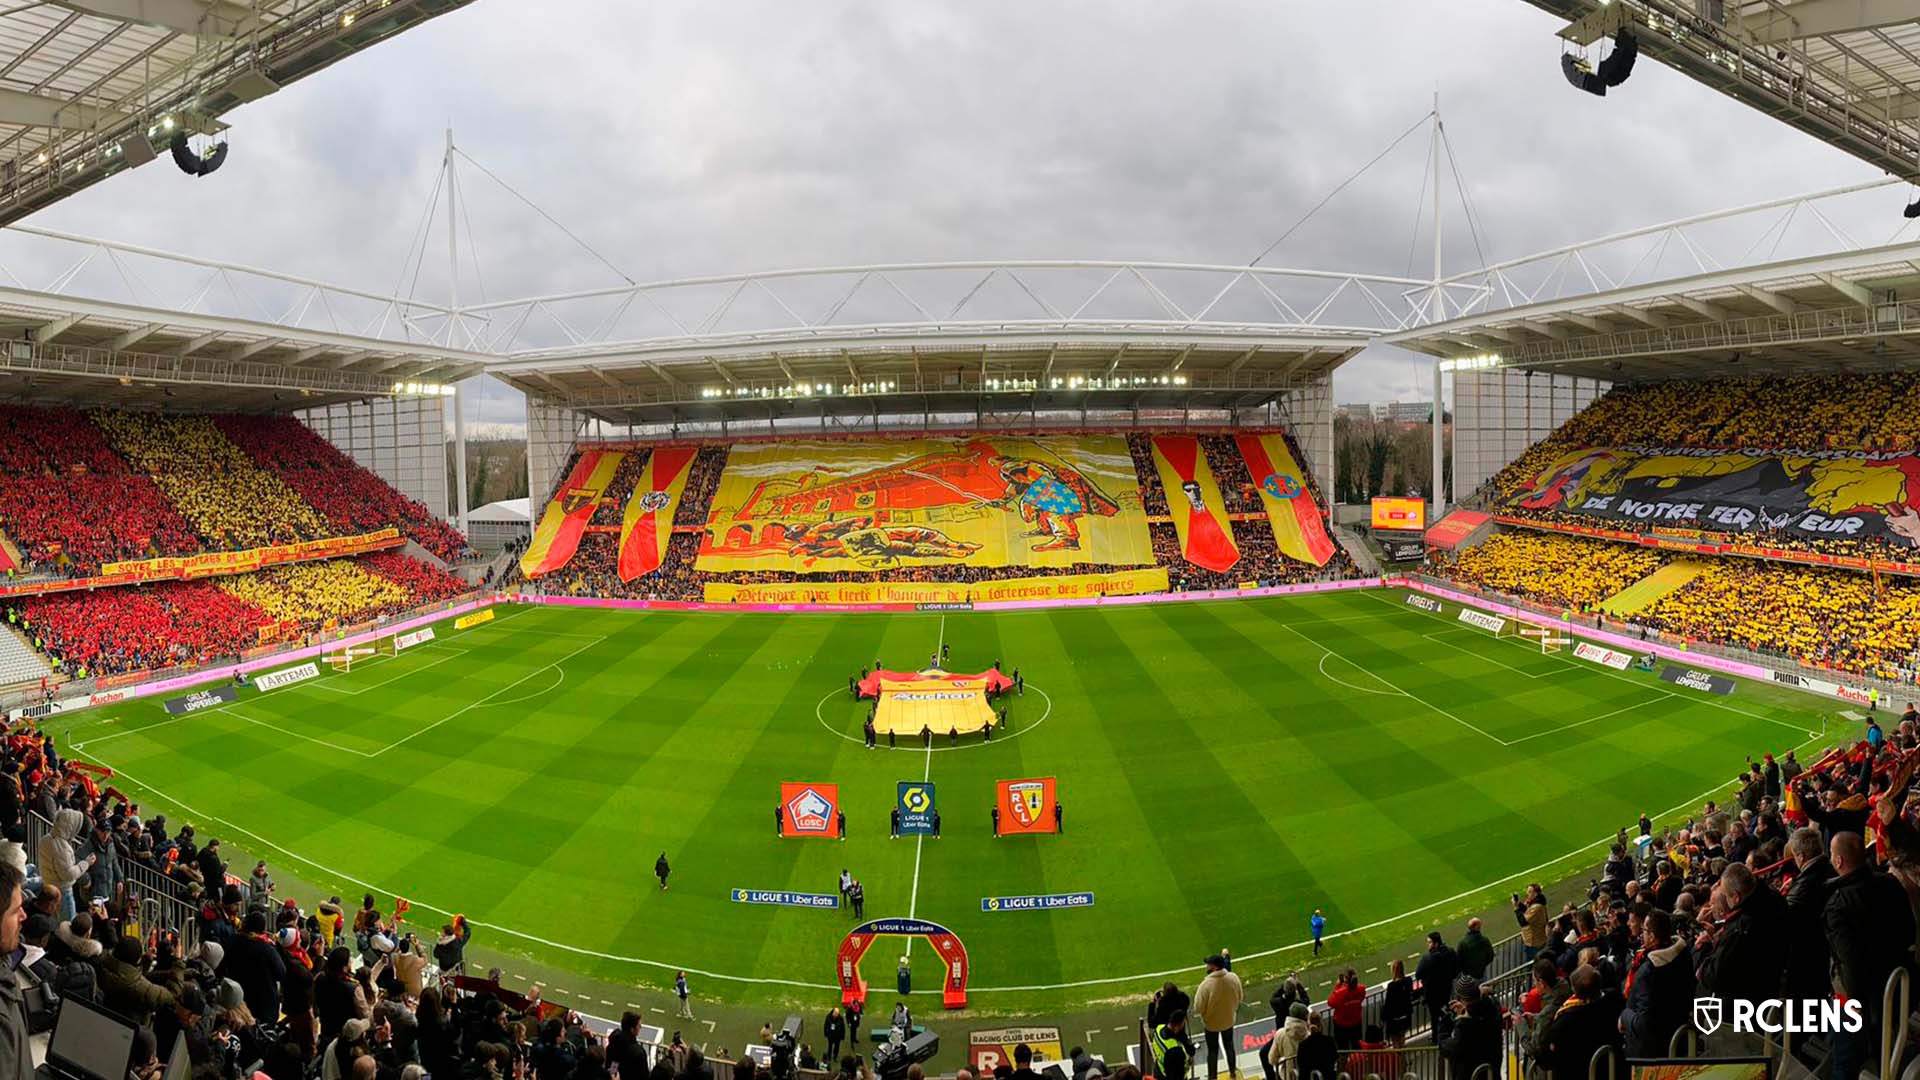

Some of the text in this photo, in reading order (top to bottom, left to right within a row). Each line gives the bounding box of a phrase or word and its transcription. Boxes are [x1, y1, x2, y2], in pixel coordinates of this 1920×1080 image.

[1582, 496, 1616, 510] DE
[1617, 498, 1705, 520] NOTRE
[118, 562, 152, 573] SOYEZ
[157, 559, 175, 569] LES
[242, 551, 255, 560] LA
[266, 666, 315, 688] ARTEMIS
[1774, 671, 1800, 686] PUMA
[90, 691, 124, 706] Auchan
[22, 703, 52, 717] PUMA
[752, 892, 782, 902] LIGUE
[792, 895, 812, 904] Uber
[812, 896, 833, 906] Eats
[1004, 898, 1035, 908] LIGUE
[1045, 897, 1066, 906] Uber
[1067, 895, 1088, 905] Eats
[972, 1035, 1002, 1043] RACING
[1002, 1034, 1023, 1042] CLUB
[1036, 1032, 1057, 1040] LENS
